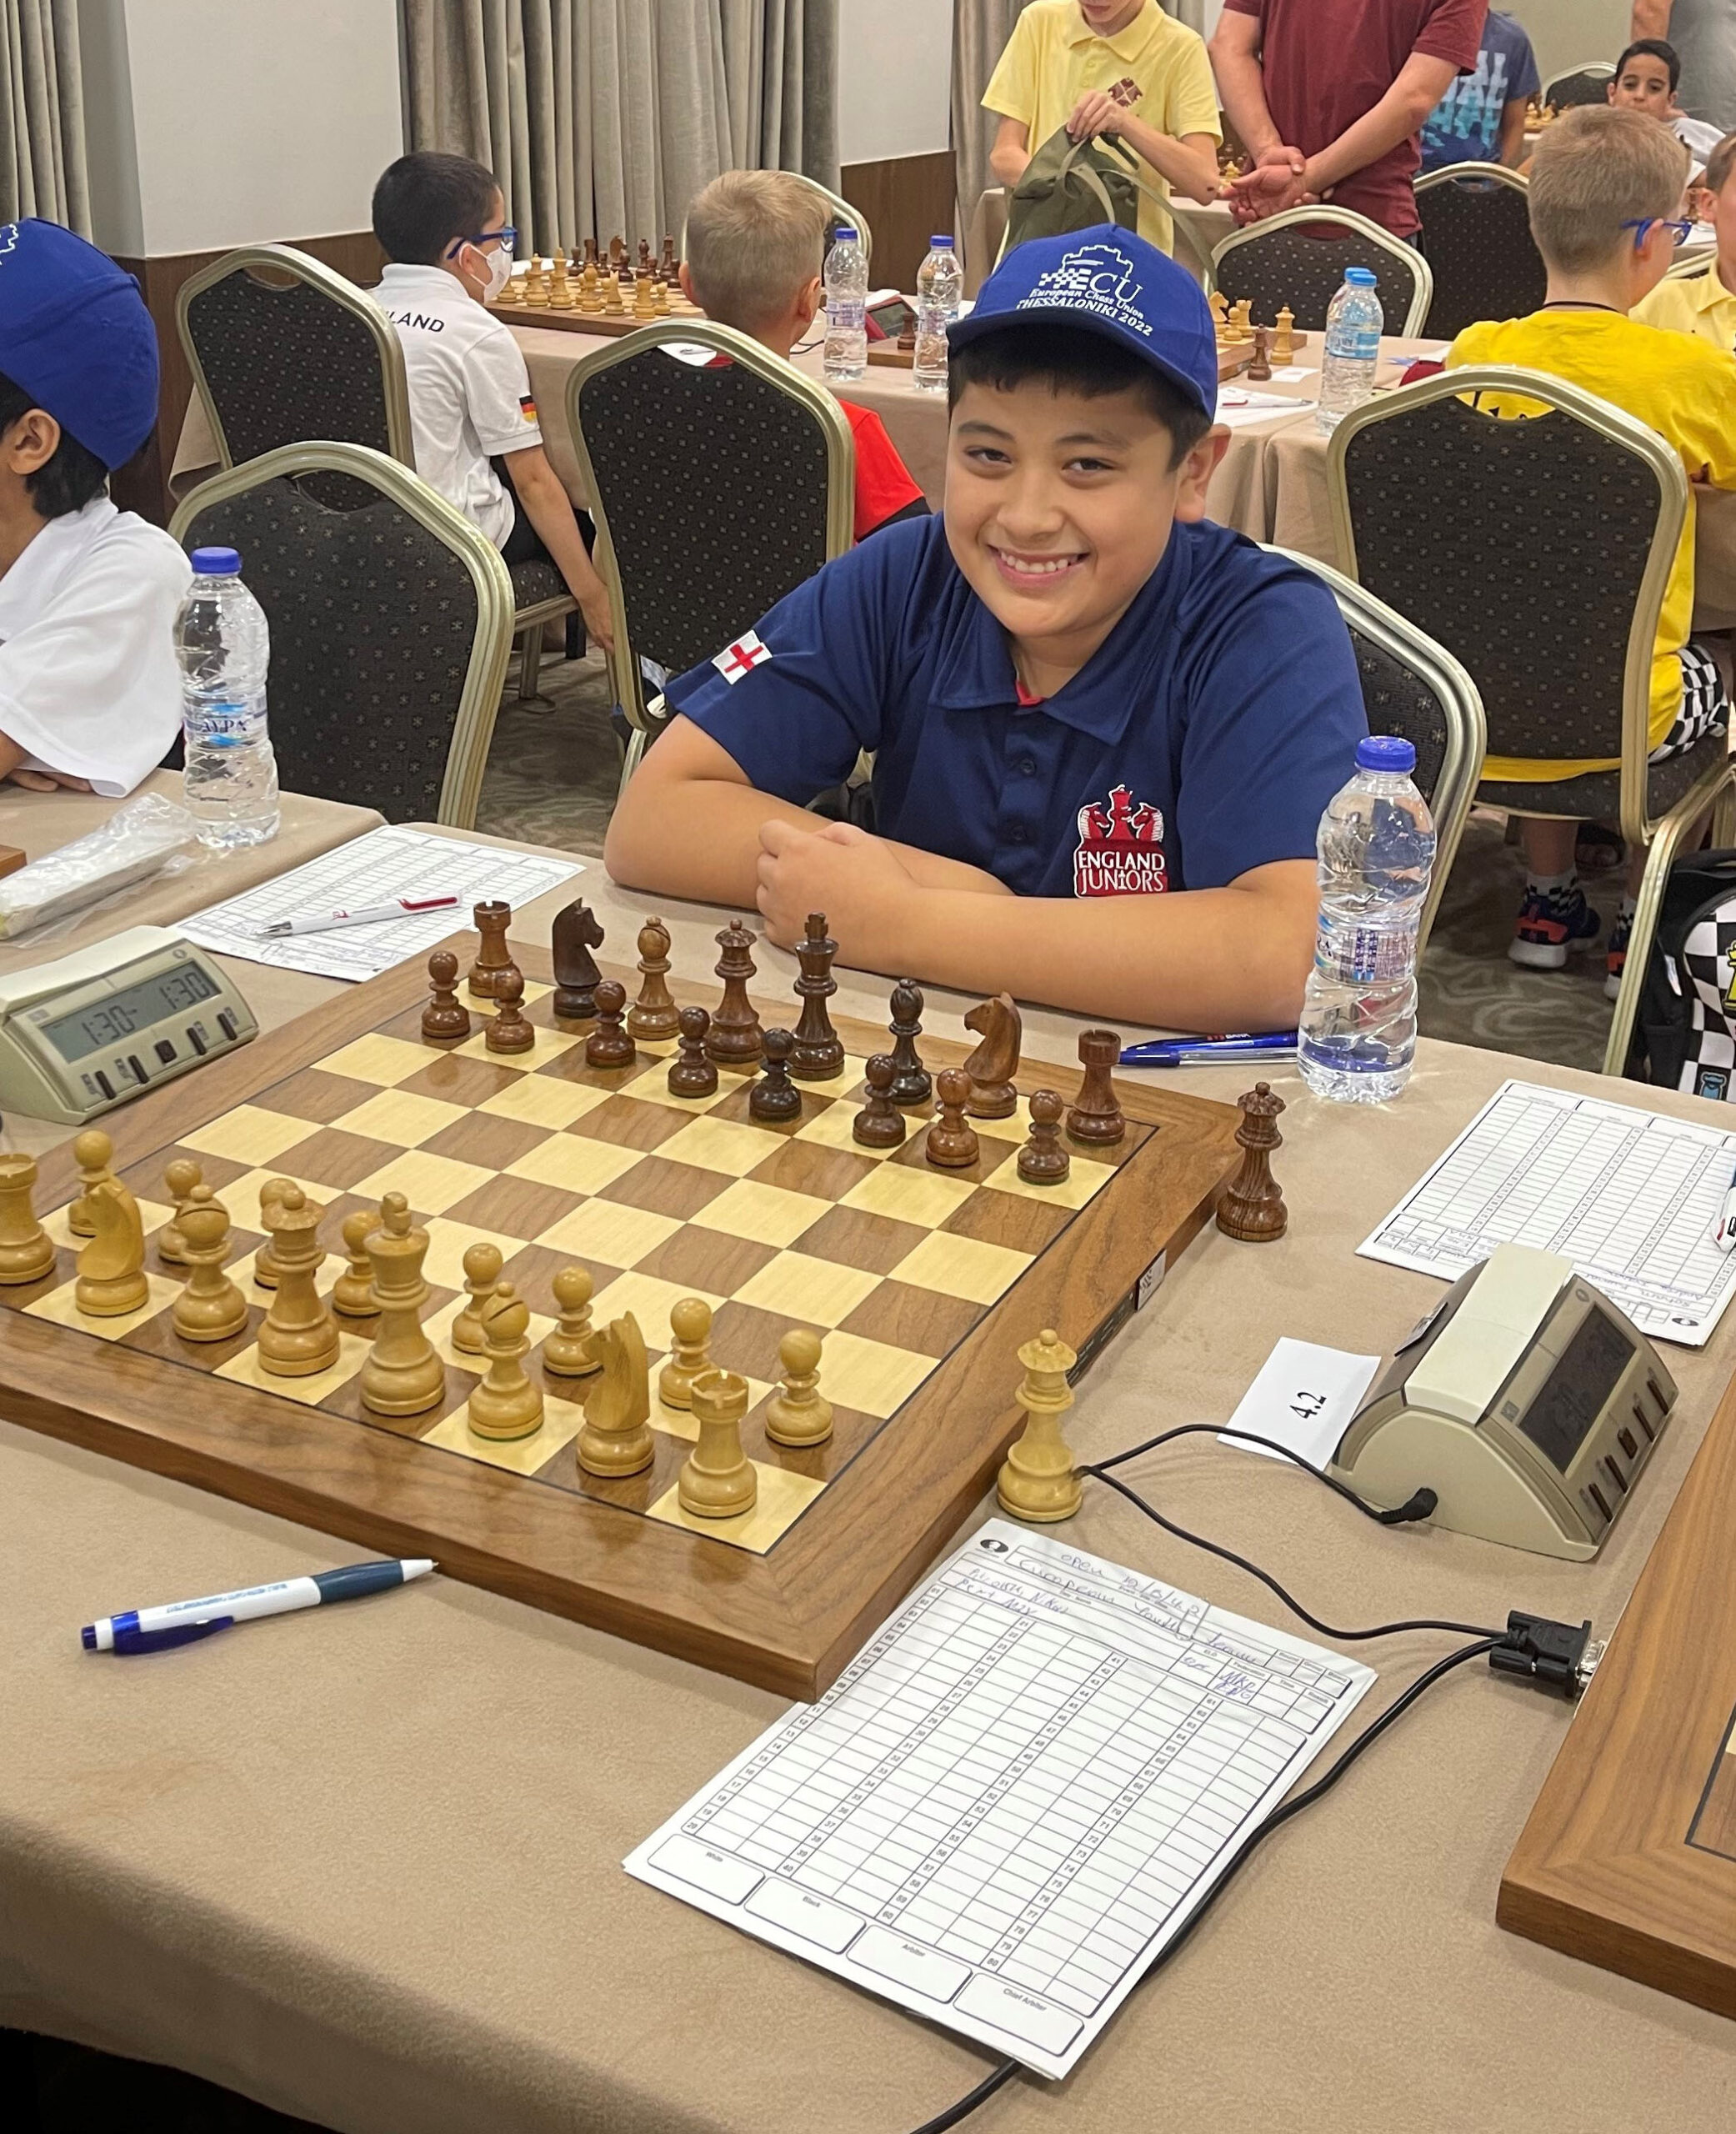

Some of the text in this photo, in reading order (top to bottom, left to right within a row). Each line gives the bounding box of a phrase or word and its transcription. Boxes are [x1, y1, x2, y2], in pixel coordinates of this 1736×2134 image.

[1028, 288, 1144, 320] European Chess Union
[1016, 297, 1153, 337] THESSALONIKI 2022
[1078, 850, 1166, 871] ENGLAND
[1080, 869, 1164, 894] JUNIORS
[1289, 1391, 1327, 1420] 4.2
[902, 1943, 926, 1957] Arbiter
[1003, 1987, 1048, 2011] Chief Arbiter
